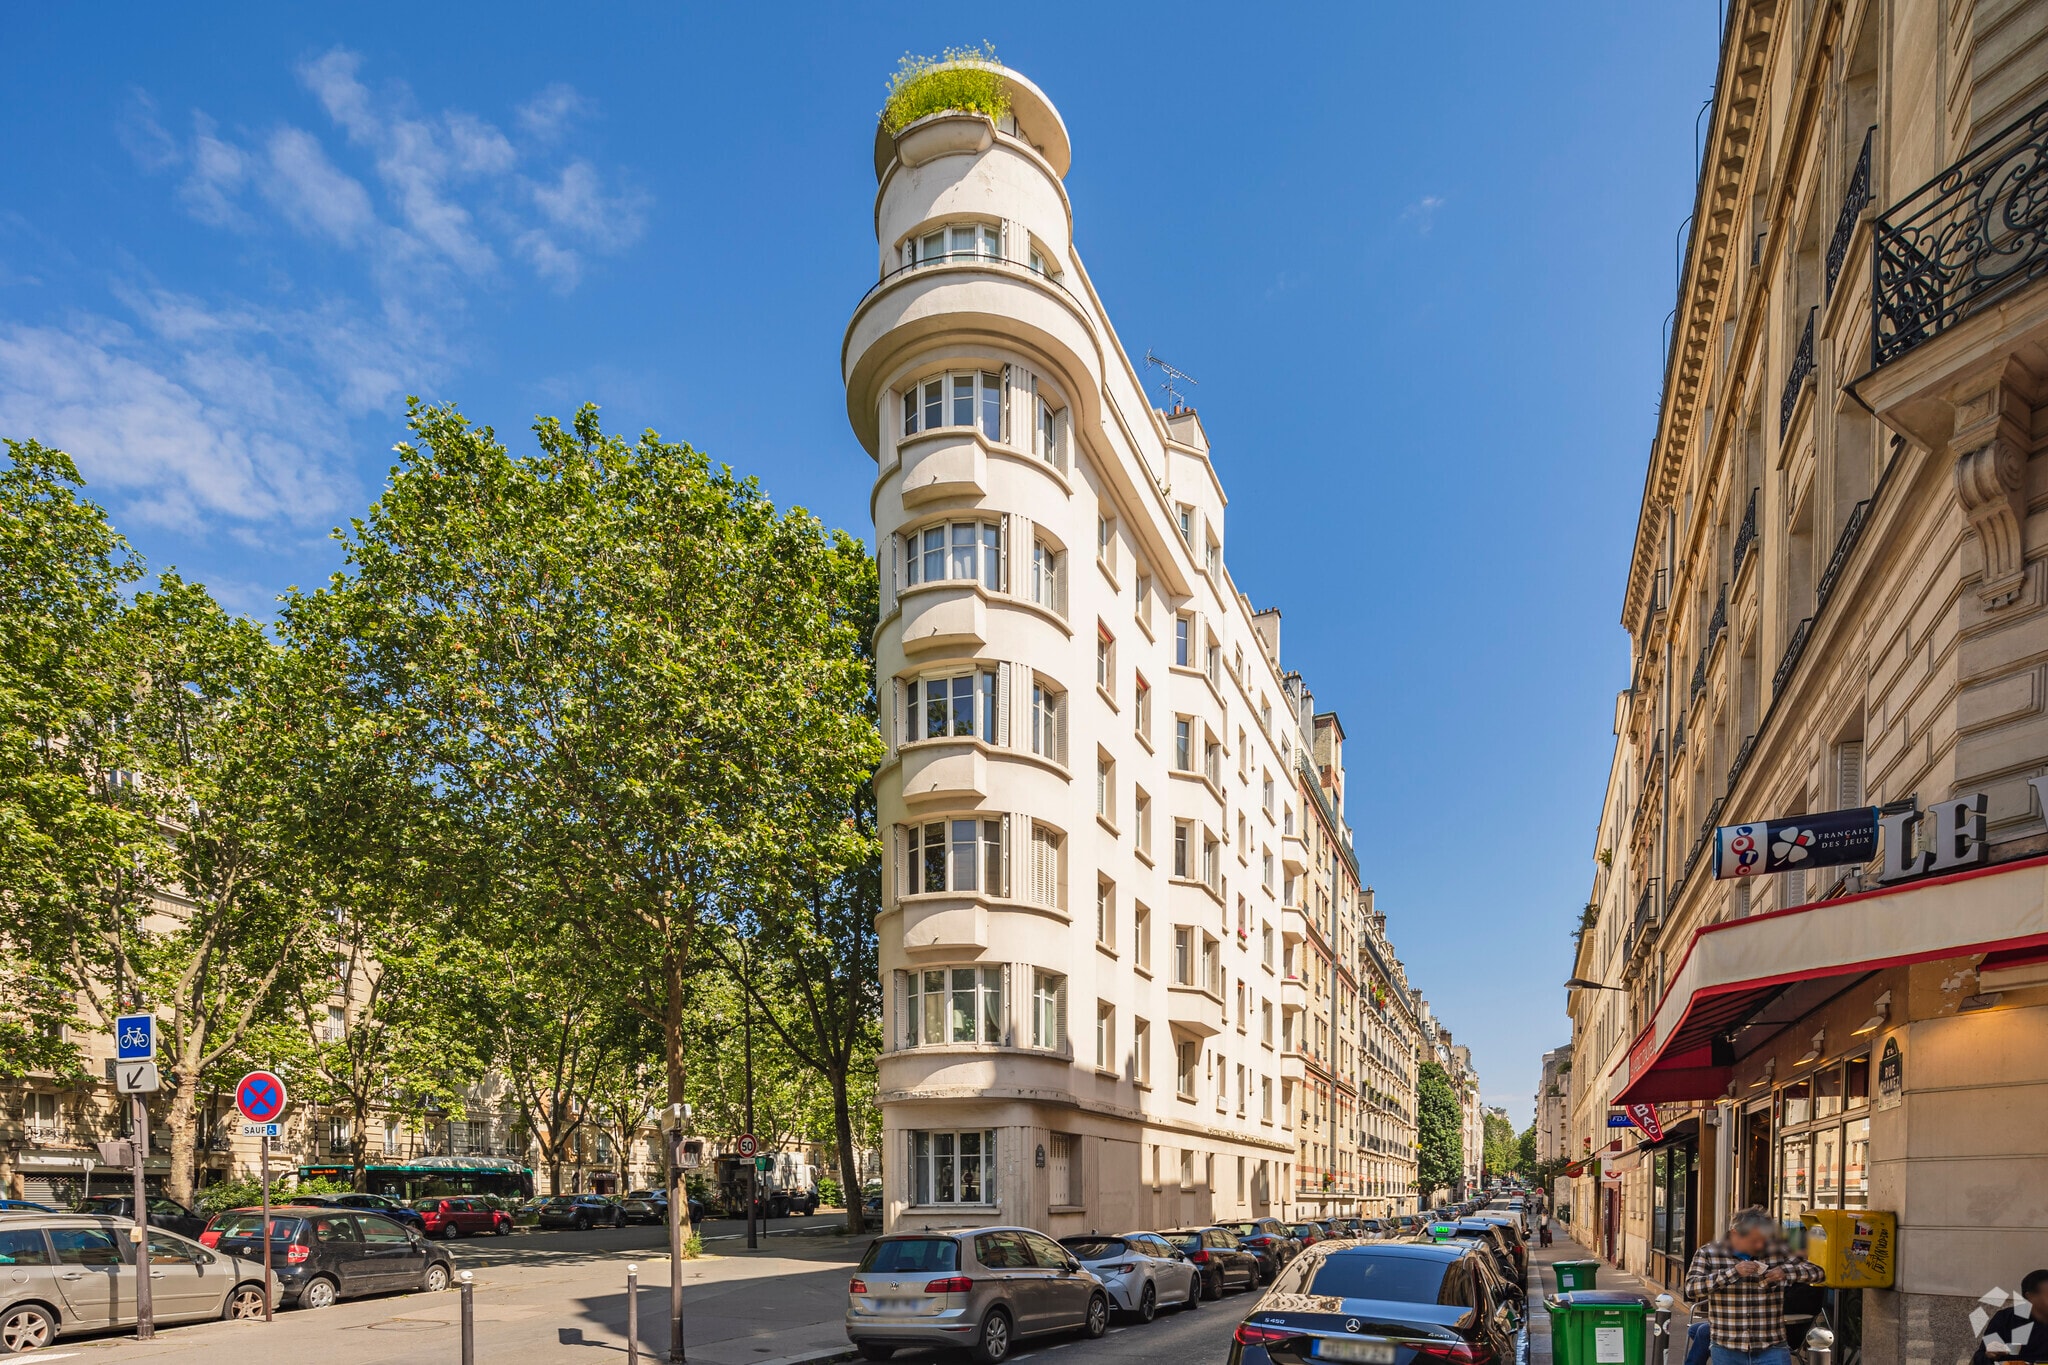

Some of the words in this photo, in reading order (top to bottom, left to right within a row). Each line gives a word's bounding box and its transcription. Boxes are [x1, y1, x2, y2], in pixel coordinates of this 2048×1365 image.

[1818, 827, 1874, 840] FRANÇAISE
[1877, 793, 1983, 883] LE
[1821, 841, 1840, 849] DES
[1844, 837, 1870, 847] JEUX
[1731, 826, 1759, 876] LOTO
[1884, 1064, 1896, 1079] RUE
[1633, 1104, 1659, 1134] BAC
[244, 1126, 266, 1134] SAUF
[741, 1141, 753, 1151] 50
